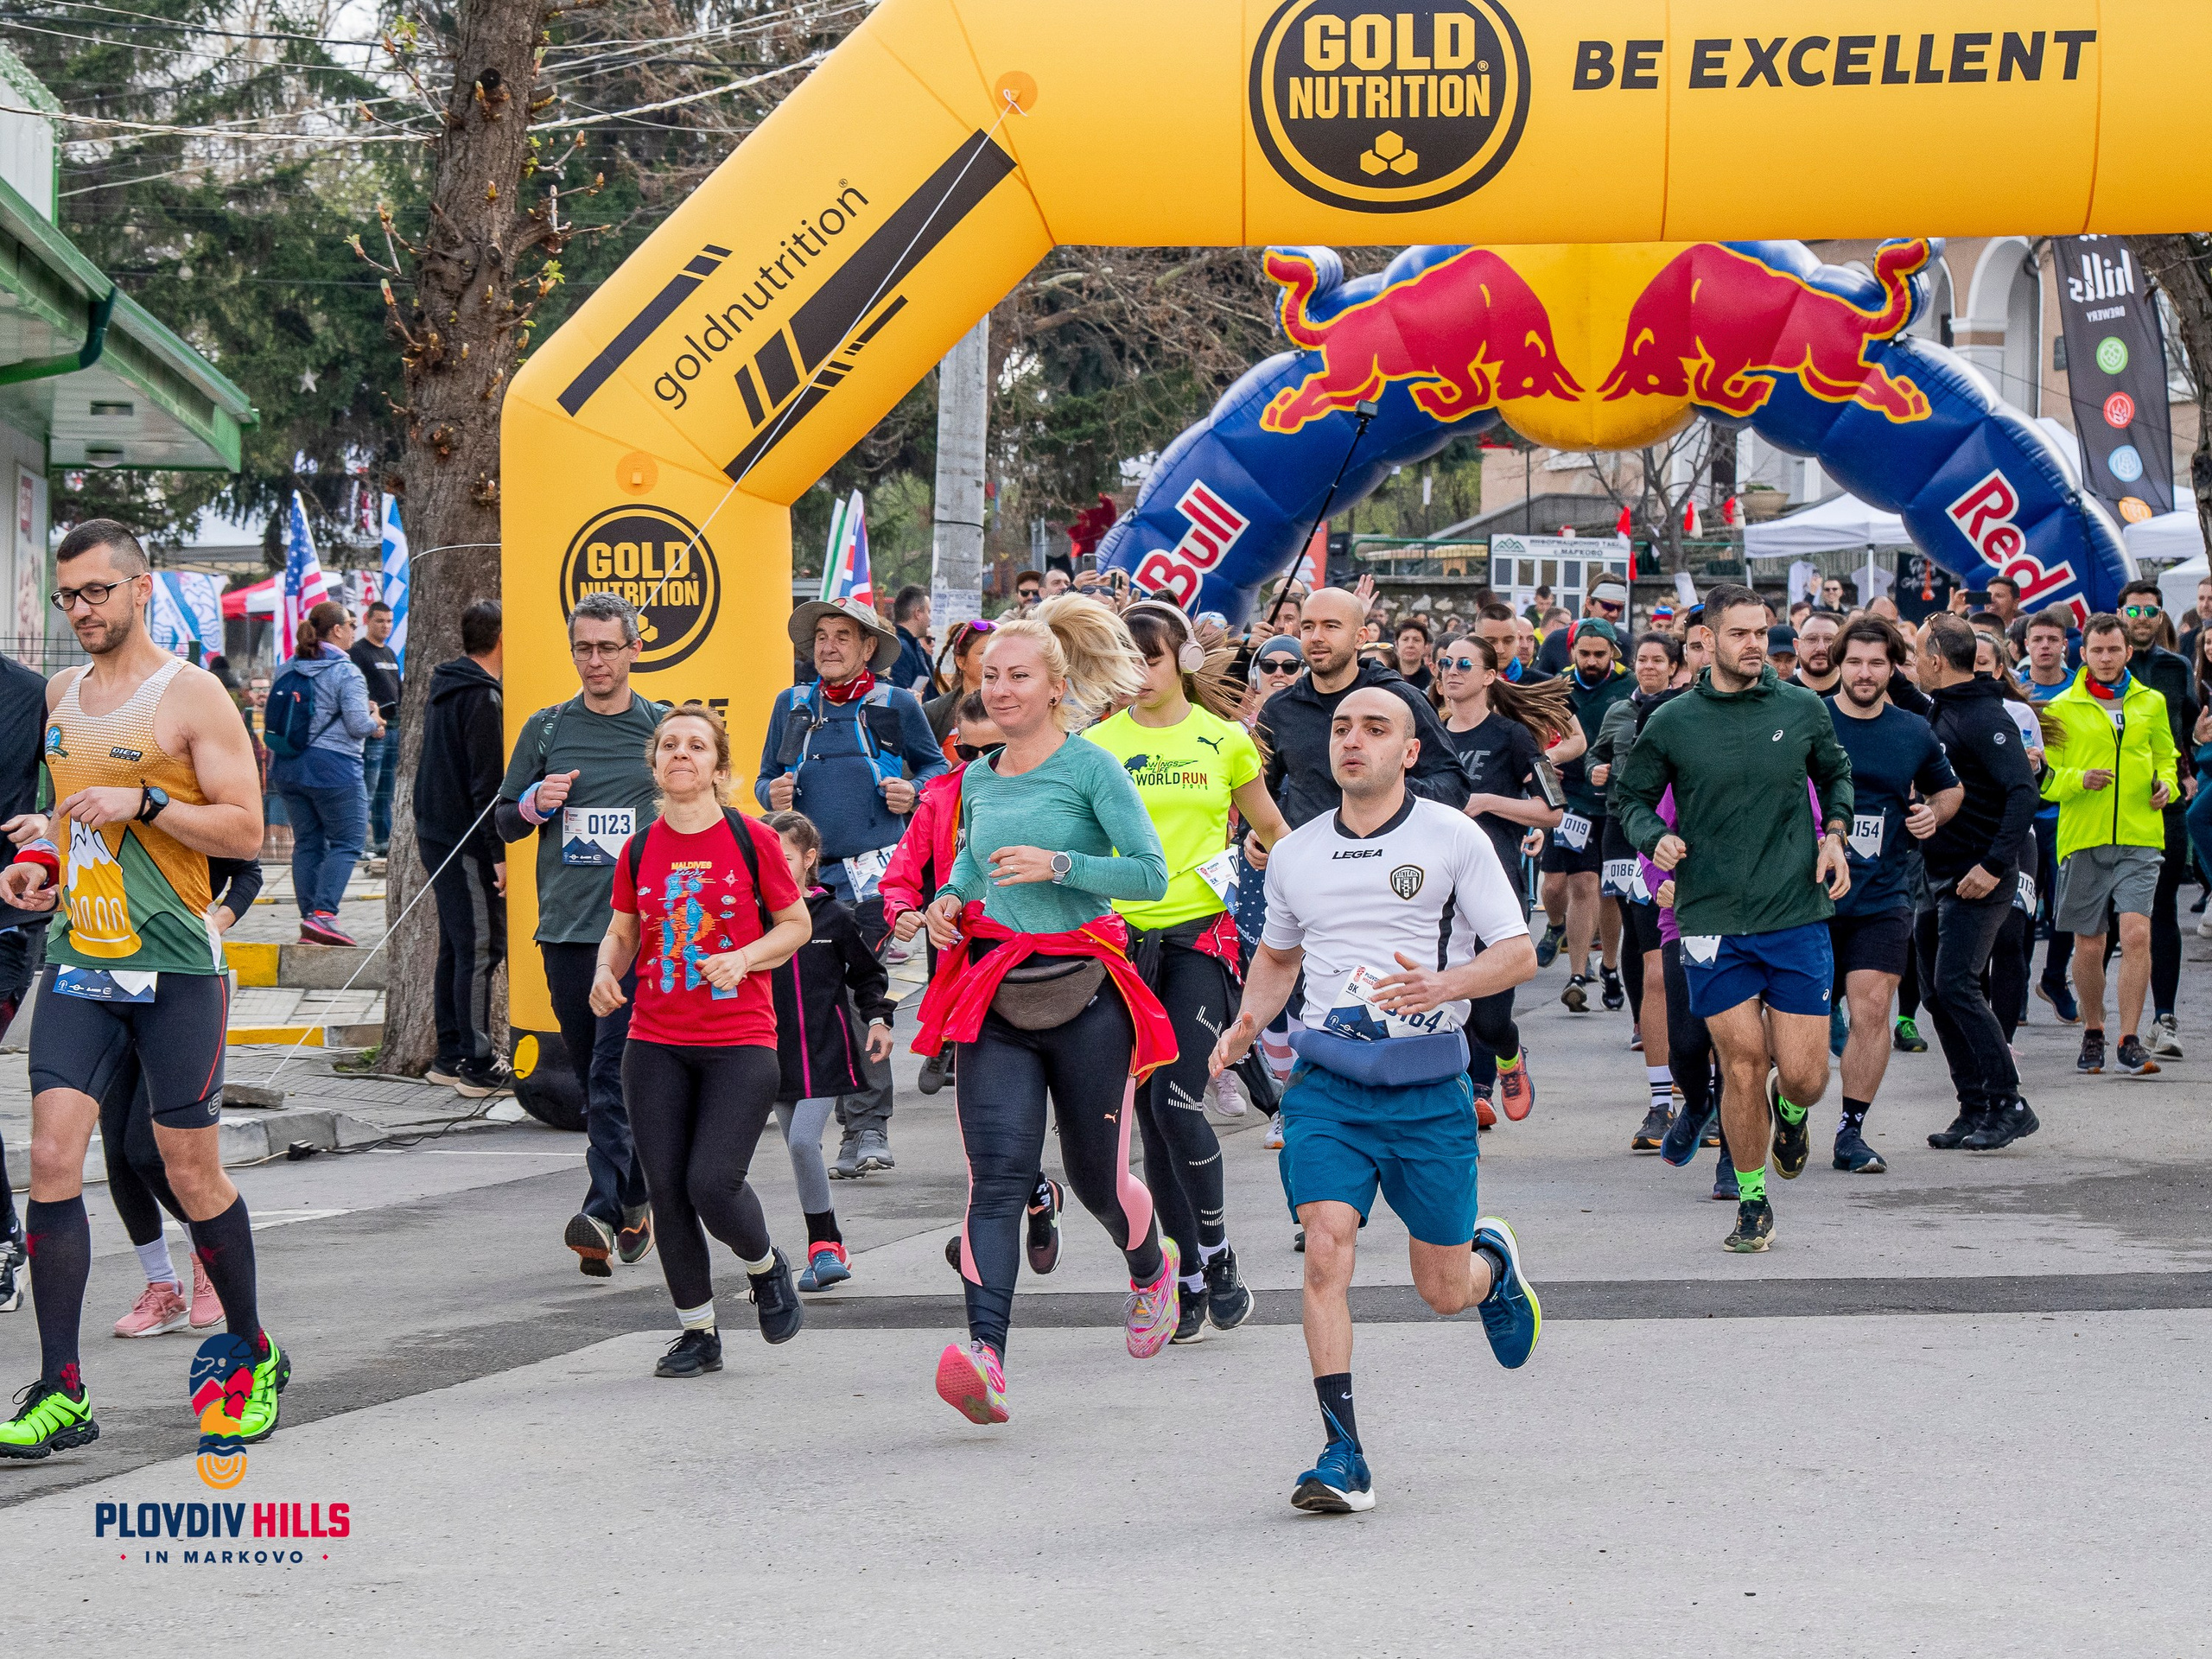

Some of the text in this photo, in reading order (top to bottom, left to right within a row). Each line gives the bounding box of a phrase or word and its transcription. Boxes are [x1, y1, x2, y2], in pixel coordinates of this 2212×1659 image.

[1303, 12, 1476, 72] GOLD
[1572, 30, 2097, 90] BE EXCELLENT
[1289, 74, 1490, 119] NUTRITION
[654, 181, 869, 410] goldnutrition
[1134, 482, 1247, 611] Bull
[1948, 473, 2073, 605] Red
[587, 541, 690, 579] GOLD
[111, 747, 141, 757] DIEM
[1136, 772, 1208, 785] WORLD RUN
[588, 814, 630, 835] 0123
[1564, 817, 1587, 836] 0119
[671, 861, 712, 870] MALDIVES
[1332, 849, 1383, 860] LEGEA
[1611, 864, 1635, 877] 0186
